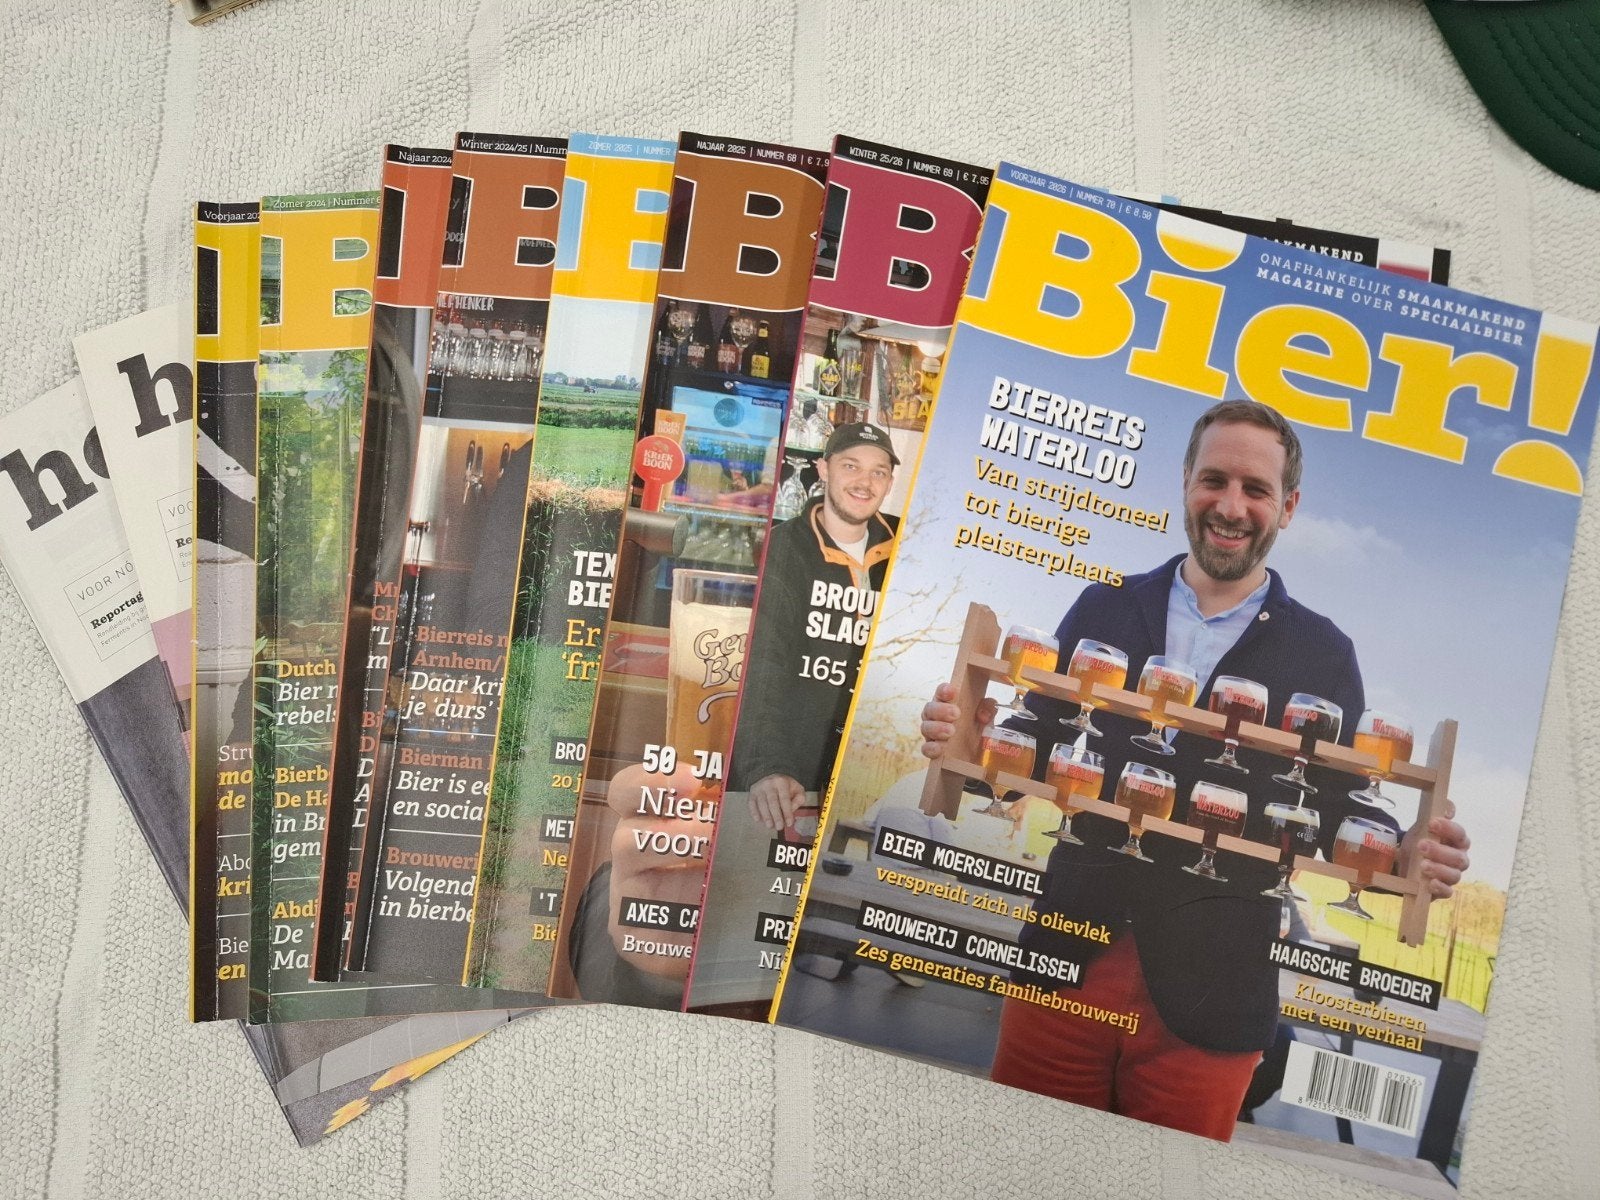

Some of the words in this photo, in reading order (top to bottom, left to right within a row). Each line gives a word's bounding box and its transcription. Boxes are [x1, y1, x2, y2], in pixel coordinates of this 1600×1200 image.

[398, 151, 430, 164] Najaar
[460, 138, 493, 150] Winter
[494, 141, 528, 153] 2024/25
[588, 141, 611, 151] ZOMER
[697, 141, 725, 152] NAJAAR
[727, 144, 746, 154] 2025
[756, 149, 785, 160] NUMMER
[787, 152, 797, 162] 68
[850, 146, 878, 161] WINTER
[880, 153, 903, 167] 25/26
[913, 161, 941, 175] NUMMER
[943, 168, 954, 178] 69
[971, 174, 990, 185] 7.95
[273, 200, 304, 209] Zomer
[306, 200, 326, 208] 2024
[333, 196, 375, 206] Nummer
[1010, 169, 1047, 187] VOORJAAR
[1048, 181, 1067, 194] 2026
[1076, 190, 1104, 206] NUMMER
[1106, 200, 1116, 209] 70
[1133, 209, 1152, 220] 8.50
[204, 210, 245, 222] Voorjaar
[1260, 253, 1391, 297] ONAFHANKELIJK
[1397, 289, 1526, 331] SMAAKMAKEND
[1256, 267, 1344, 299] MAGAZINE
[1351, 292, 1394, 312] OVER
[1400, 305, 1524, 346] SPECIAALBIER
[957, 177, 1600, 497] Bier!
[988, 376, 1145, 450] BIERREIS
[979, 413, 1136, 489] WATERLOO
[974, 455, 1018, 490] Van
[1024, 475, 1169, 534] strijdtoneel
[964, 491, 1001, 518] tot
[1006, 500, 1091, 546] bierige
[573, 550, 617, 578] TEX
[954, 523, 1125, 589] pleisterplaats
[77, 575, 112, 601] VOOR
[568, 580, 613, 609] BIE
[90, 590, 144, 629] Reportag
[416, 626, 493, 646] Bierreis
[564, 619, 601, 647] Er
[805, 611, 870, 646] SLAG
[277, 659, 337, 678] Dutch
[412, 651, 506, 673] Arnhem/
[798, 655, 848, 686] 165
[277, 682, 323, 701] Bier
[409, 671, 469, 693] Daar
[402, 696, 427, 720] je
[400, 747, 483, 770] Bierman
[555, 742, 586, 762] BRO
[643, 744, 677, 774] 50
[691, 749, 723, 780] JA
[275, 765, 330, 784] Bierb
[396, 770, 444, 793] Bier
[447, 773, 466, 795] is
[552, 775, 573, 789] 20
[218, 790, 246, 810] de
[275, 791, 301, 809] De
[393, 800, 419, 817] en
[424, 801, 487, 821] socia
[636, 785, 718, 823] Nieu
[275, 814, 297, 834] in
[274, 840, 322, 863] gem
[632, 829, 710, 859] voor
[882, 832, 926, 861] BIER
[932, 846, 1043, 895] MOERSLEUTEL
[385, 870, 477, 897] Volgend
[769, 876, 791, 896] Al
[379, 895, 401, 917] in
[626, 902, 670, 926] AXES
[876, 867, 969, 905] verspreidt
[972, 892, 1008, 916] zich
[1011, 904, 1038, 923] als
[1041, 912, 1111, 944] olievlek
[219, 937, 249, 955] Bie
[272, 924, 304, 945] De
[863, 906, 958, 949] BROUWERIJ
[965, 935, 1080, 983] CORNELISSEN
[218, 963, 246, 980] en
[272, 950, 312, 970] Ma
[758, 951, 784, 970] Ni
[1269, 942, 1352, 982] HAAGSCHE
[1359, 967, 1433, 1003] BROEDER
[855, 939, 888, 963] Zes
[891, 952, 986, 990] generaties
[987, 975, 1140, 1035] familiebrouwerij
[1294, 982, 1427, 1033] Kloosterbieren
[1280, 1001, 1316, 1023] met
[1319, 1012, 1350, 1033] een
[1355, 1022, 1423, 1052] verhaal
